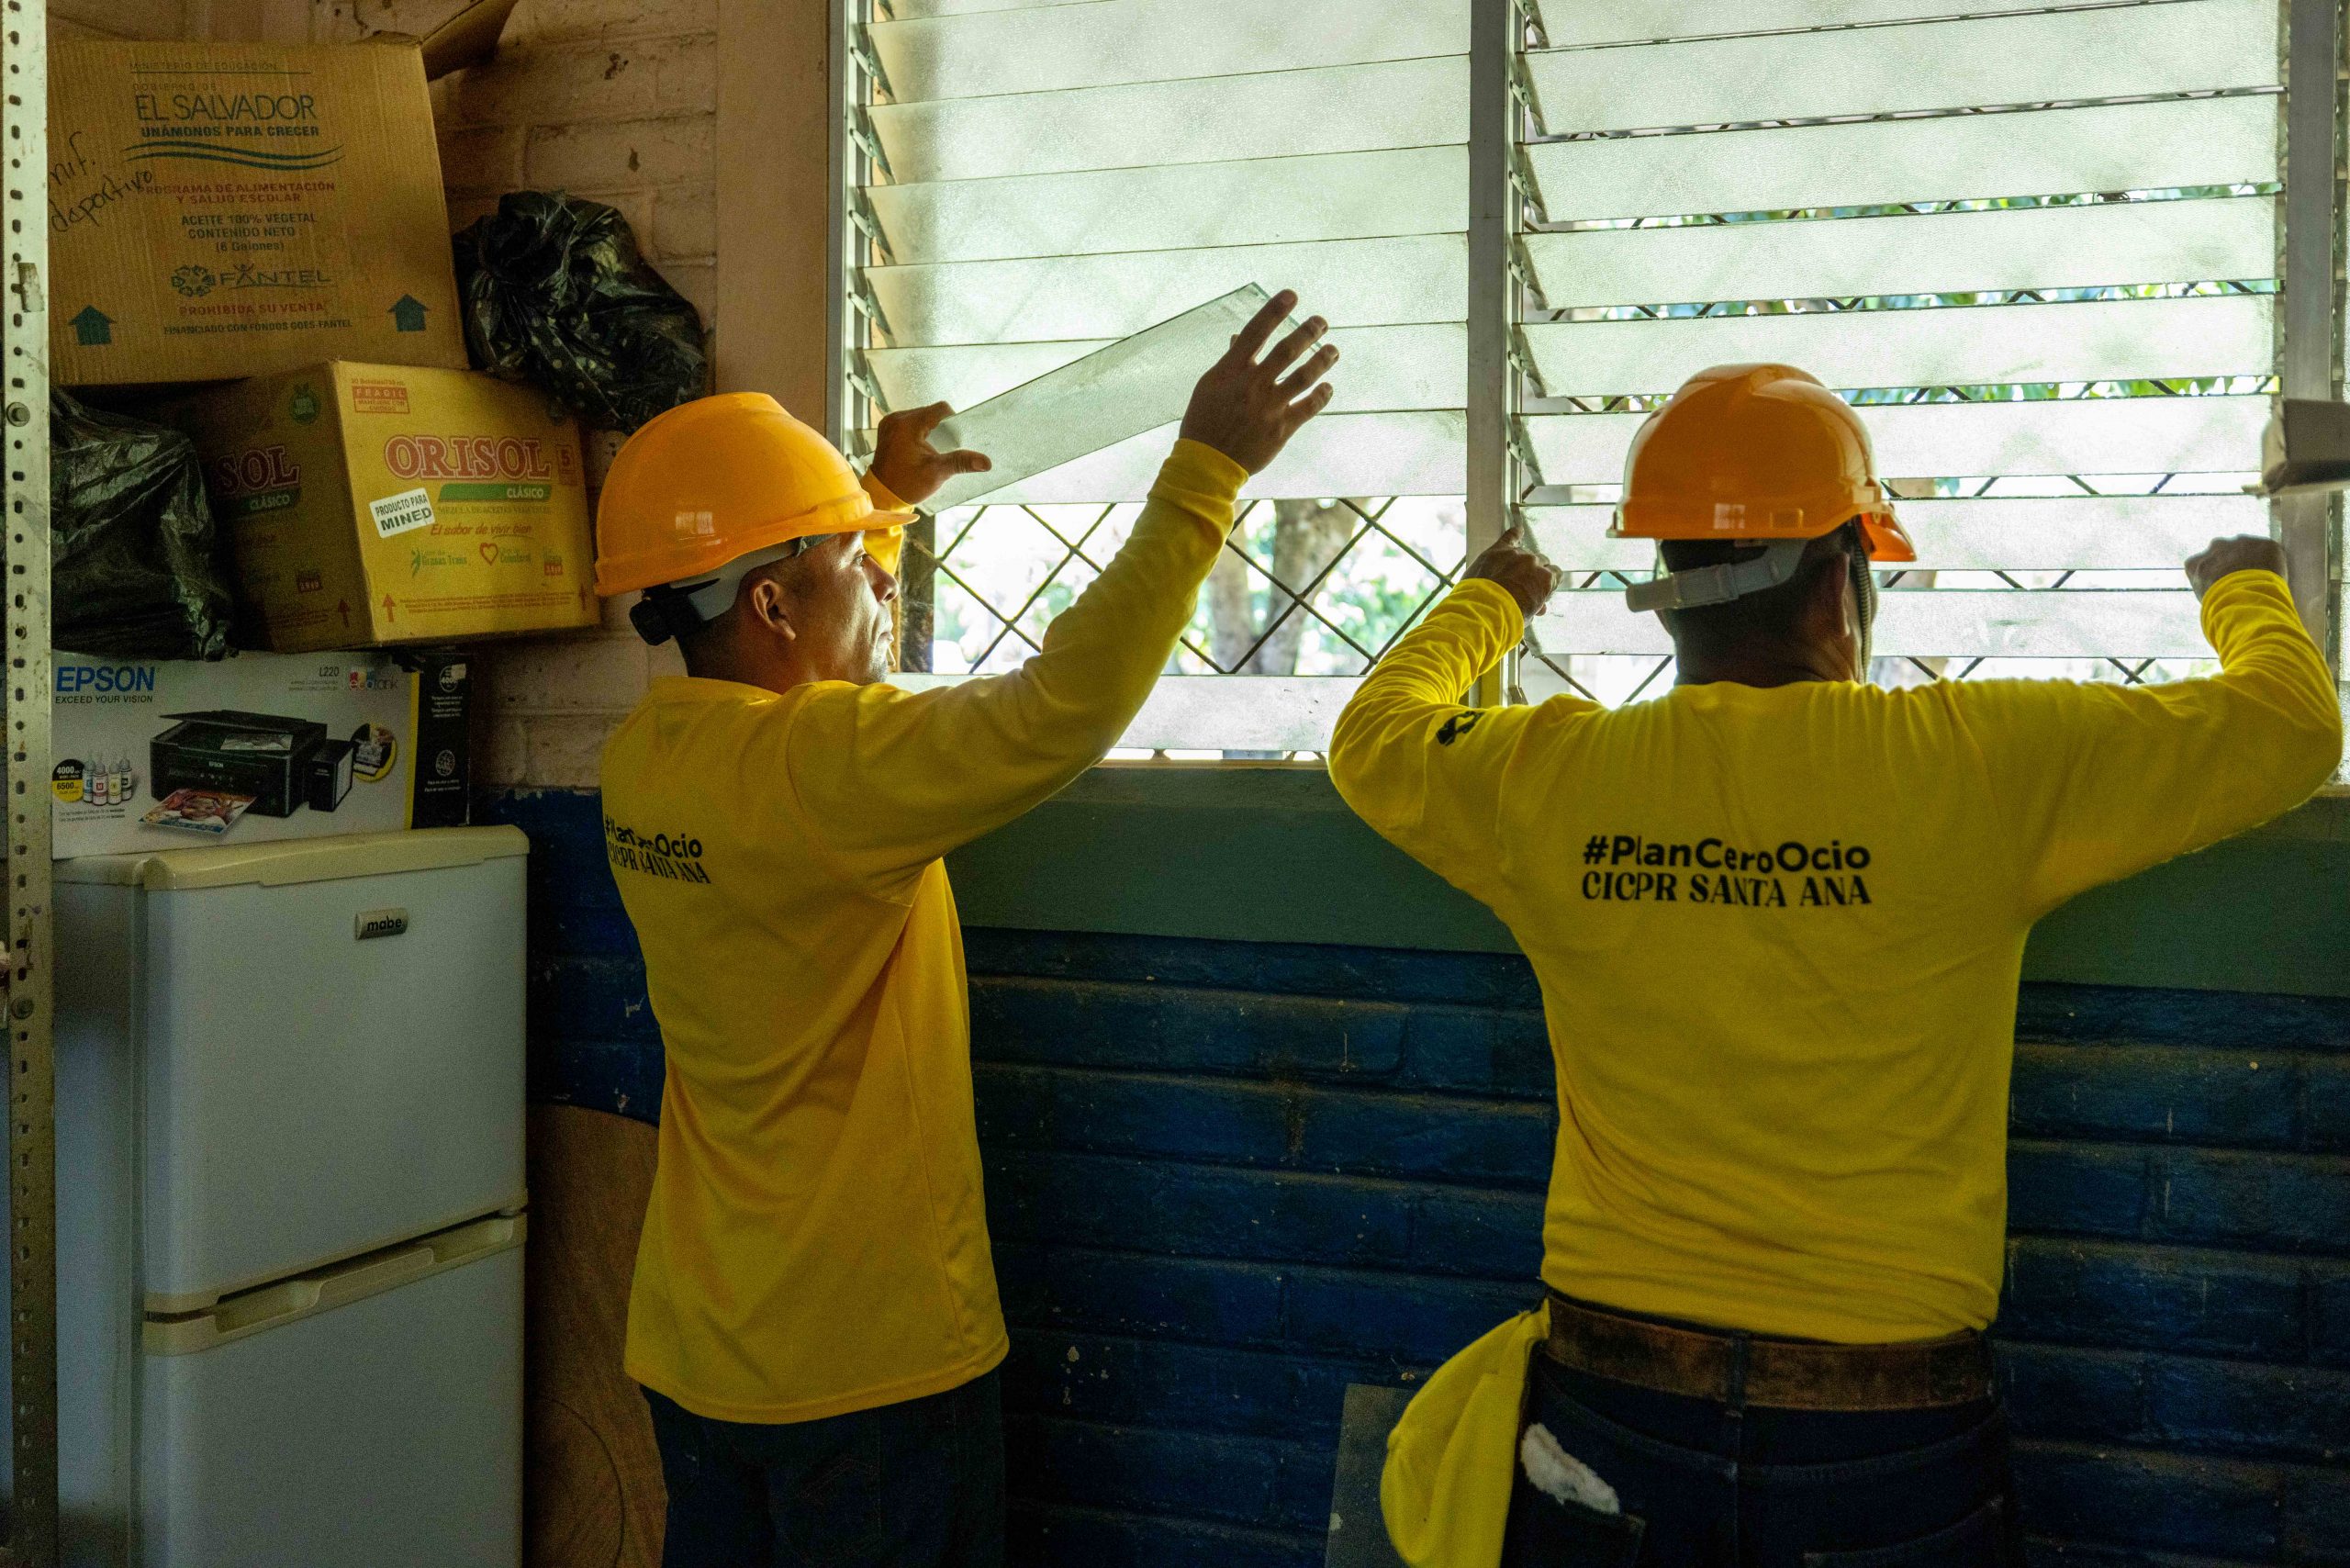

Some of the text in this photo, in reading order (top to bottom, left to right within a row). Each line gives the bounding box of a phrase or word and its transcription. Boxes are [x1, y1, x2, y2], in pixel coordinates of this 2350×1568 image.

[196, 62, 208, 71] DE
[132, 83, 218, 92] GOBIERNO DE
[135, 94, 318, 121] EL SALVADOR
[140, 125, 319, 138] UNÁMONOS PARA CRECER
[48, 131, 95, 190] nif.
[139, 184, 211, 195] PROGRAMA
[213, 184, 232, 193] DE
[176, 194, 302, 204] Y SALUD ESCOLAR
[181, 212, 318, 226] ACEITE 100% VEGETAL
[188, 228, 260, 240] CONTENIDO
[263, 227, 297, 238] NETO
[219, 264, 331, 285] FANTEL
[178, 303, 325, 316] PROHIBIDA SU VENTA
[163, 324, 225, 335] FINANCIADO
[227, 323, 249, 332] CON
[249, 322, 288, 331] FONDOS
[384, 434, 551, 480] ORISOL
[216, 444, 300, 495] SOL
[507, 487, 544, 499] CLÁSICO
[250, 493, 291, 511] CLÁSICO
[375, 494, 428, 517] PRODUCTO PARA
[380, 507, 432, 531] MINED
[430, 523, 441, 535] El
[442, 523, 472, 535] sabor
[476, 522, 488, 534] de
[319, 666, 340, 678] L220
[56, 666, 156, 692] EPSON
[55, 694, 153, 704] EXCEED YOUR VISION
[57, 766, 75, 775] 4000
[57, 782, 74, 790] 6500
[1583, 834, 1872, 874] #PlanCeroOcio
[675, 861, 711, 884] ANA
[1582, 870, 1873, 907] CICPR SANTA ANA
[367, 914, 403, 932] mabe
